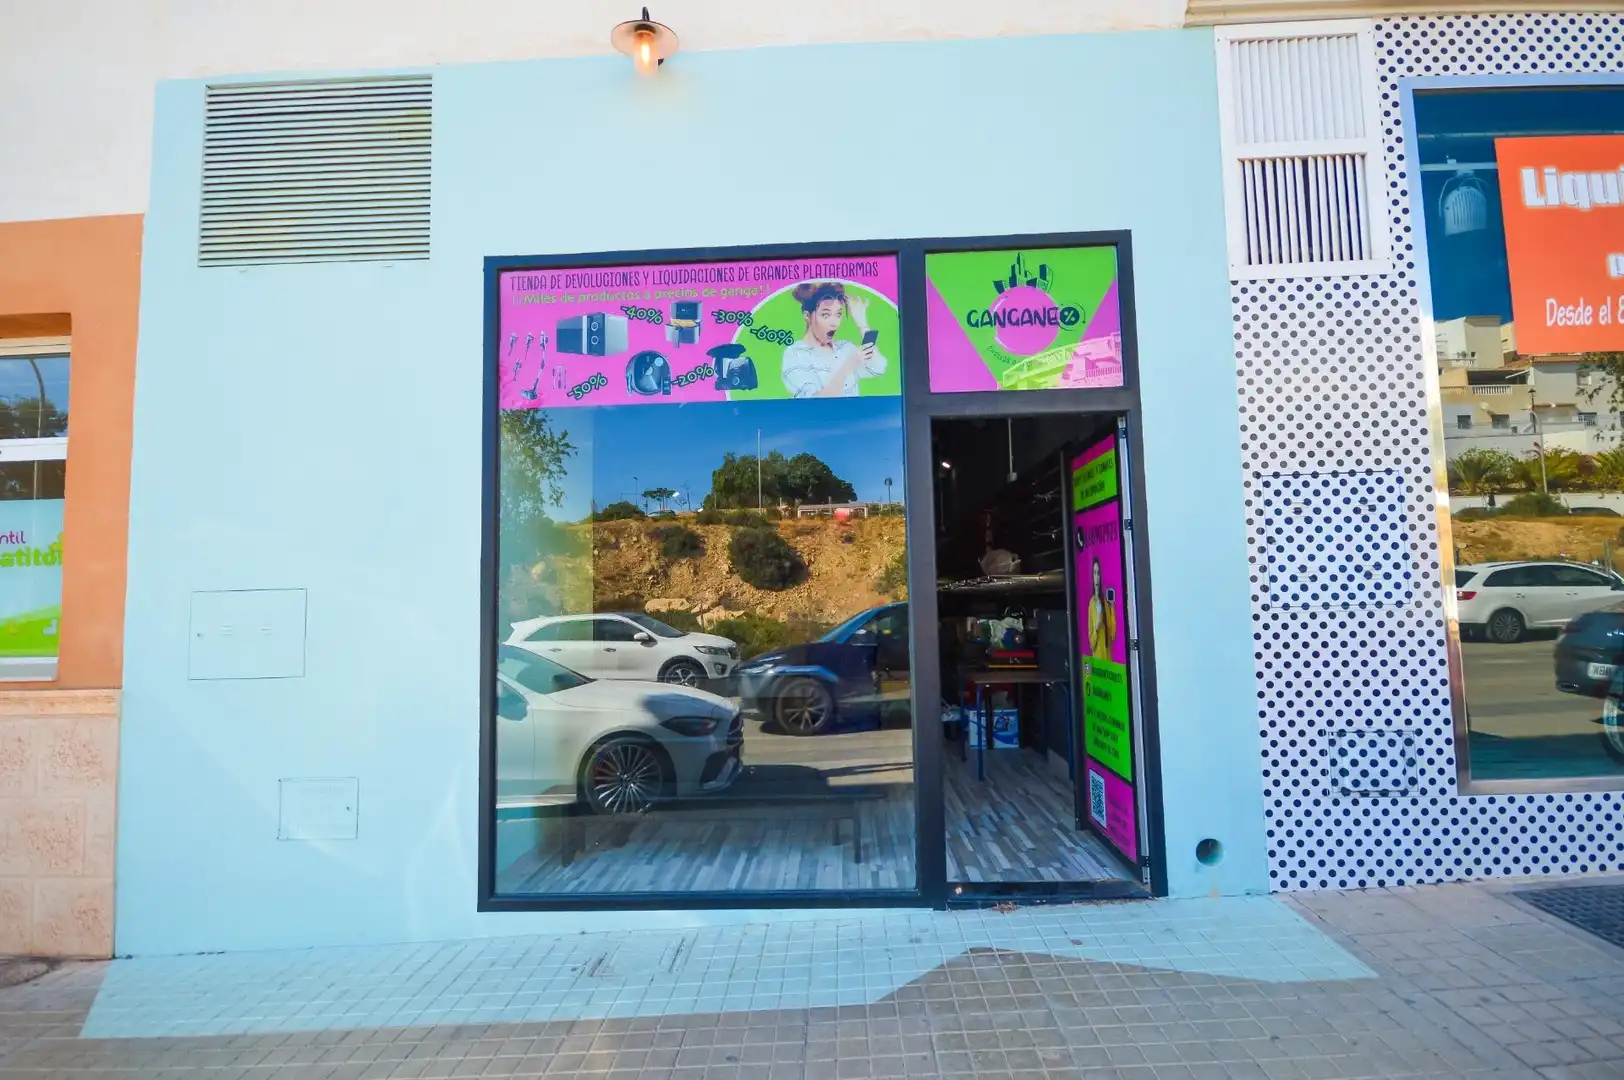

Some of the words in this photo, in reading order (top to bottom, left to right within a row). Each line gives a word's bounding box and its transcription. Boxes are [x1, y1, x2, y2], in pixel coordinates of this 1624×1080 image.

[510, 274, 548, 292] TIENDA
[551, 274, 562, 290] DE
[565, 271, 640, 289] DEVOLUCIONES
[643, 271, 650, 286] Y
[652, 267, 735, 285] LIQUIDACIONES
[738, 267, 750, 282] DE
[753, 264, 800, 281] GRANDES
[803, 261, 879, 279] PLATAFORMAS
[561, 291, 575, 303] de
[578, 289, 640, 304] productos
[655, 287, 698, 301] precios
[703, 285, 716, 297] de
[621, 305, 664, 325] -40%
[712, 309, 753, 327] -30%
[1546, 297, 1593, 327] Desde
[1599, 296, 1612, 325] el
[750, 325, 795, 346] -60%
[670, 362, 715, 387] -20%
[567, 372, 608, 401] -50%
